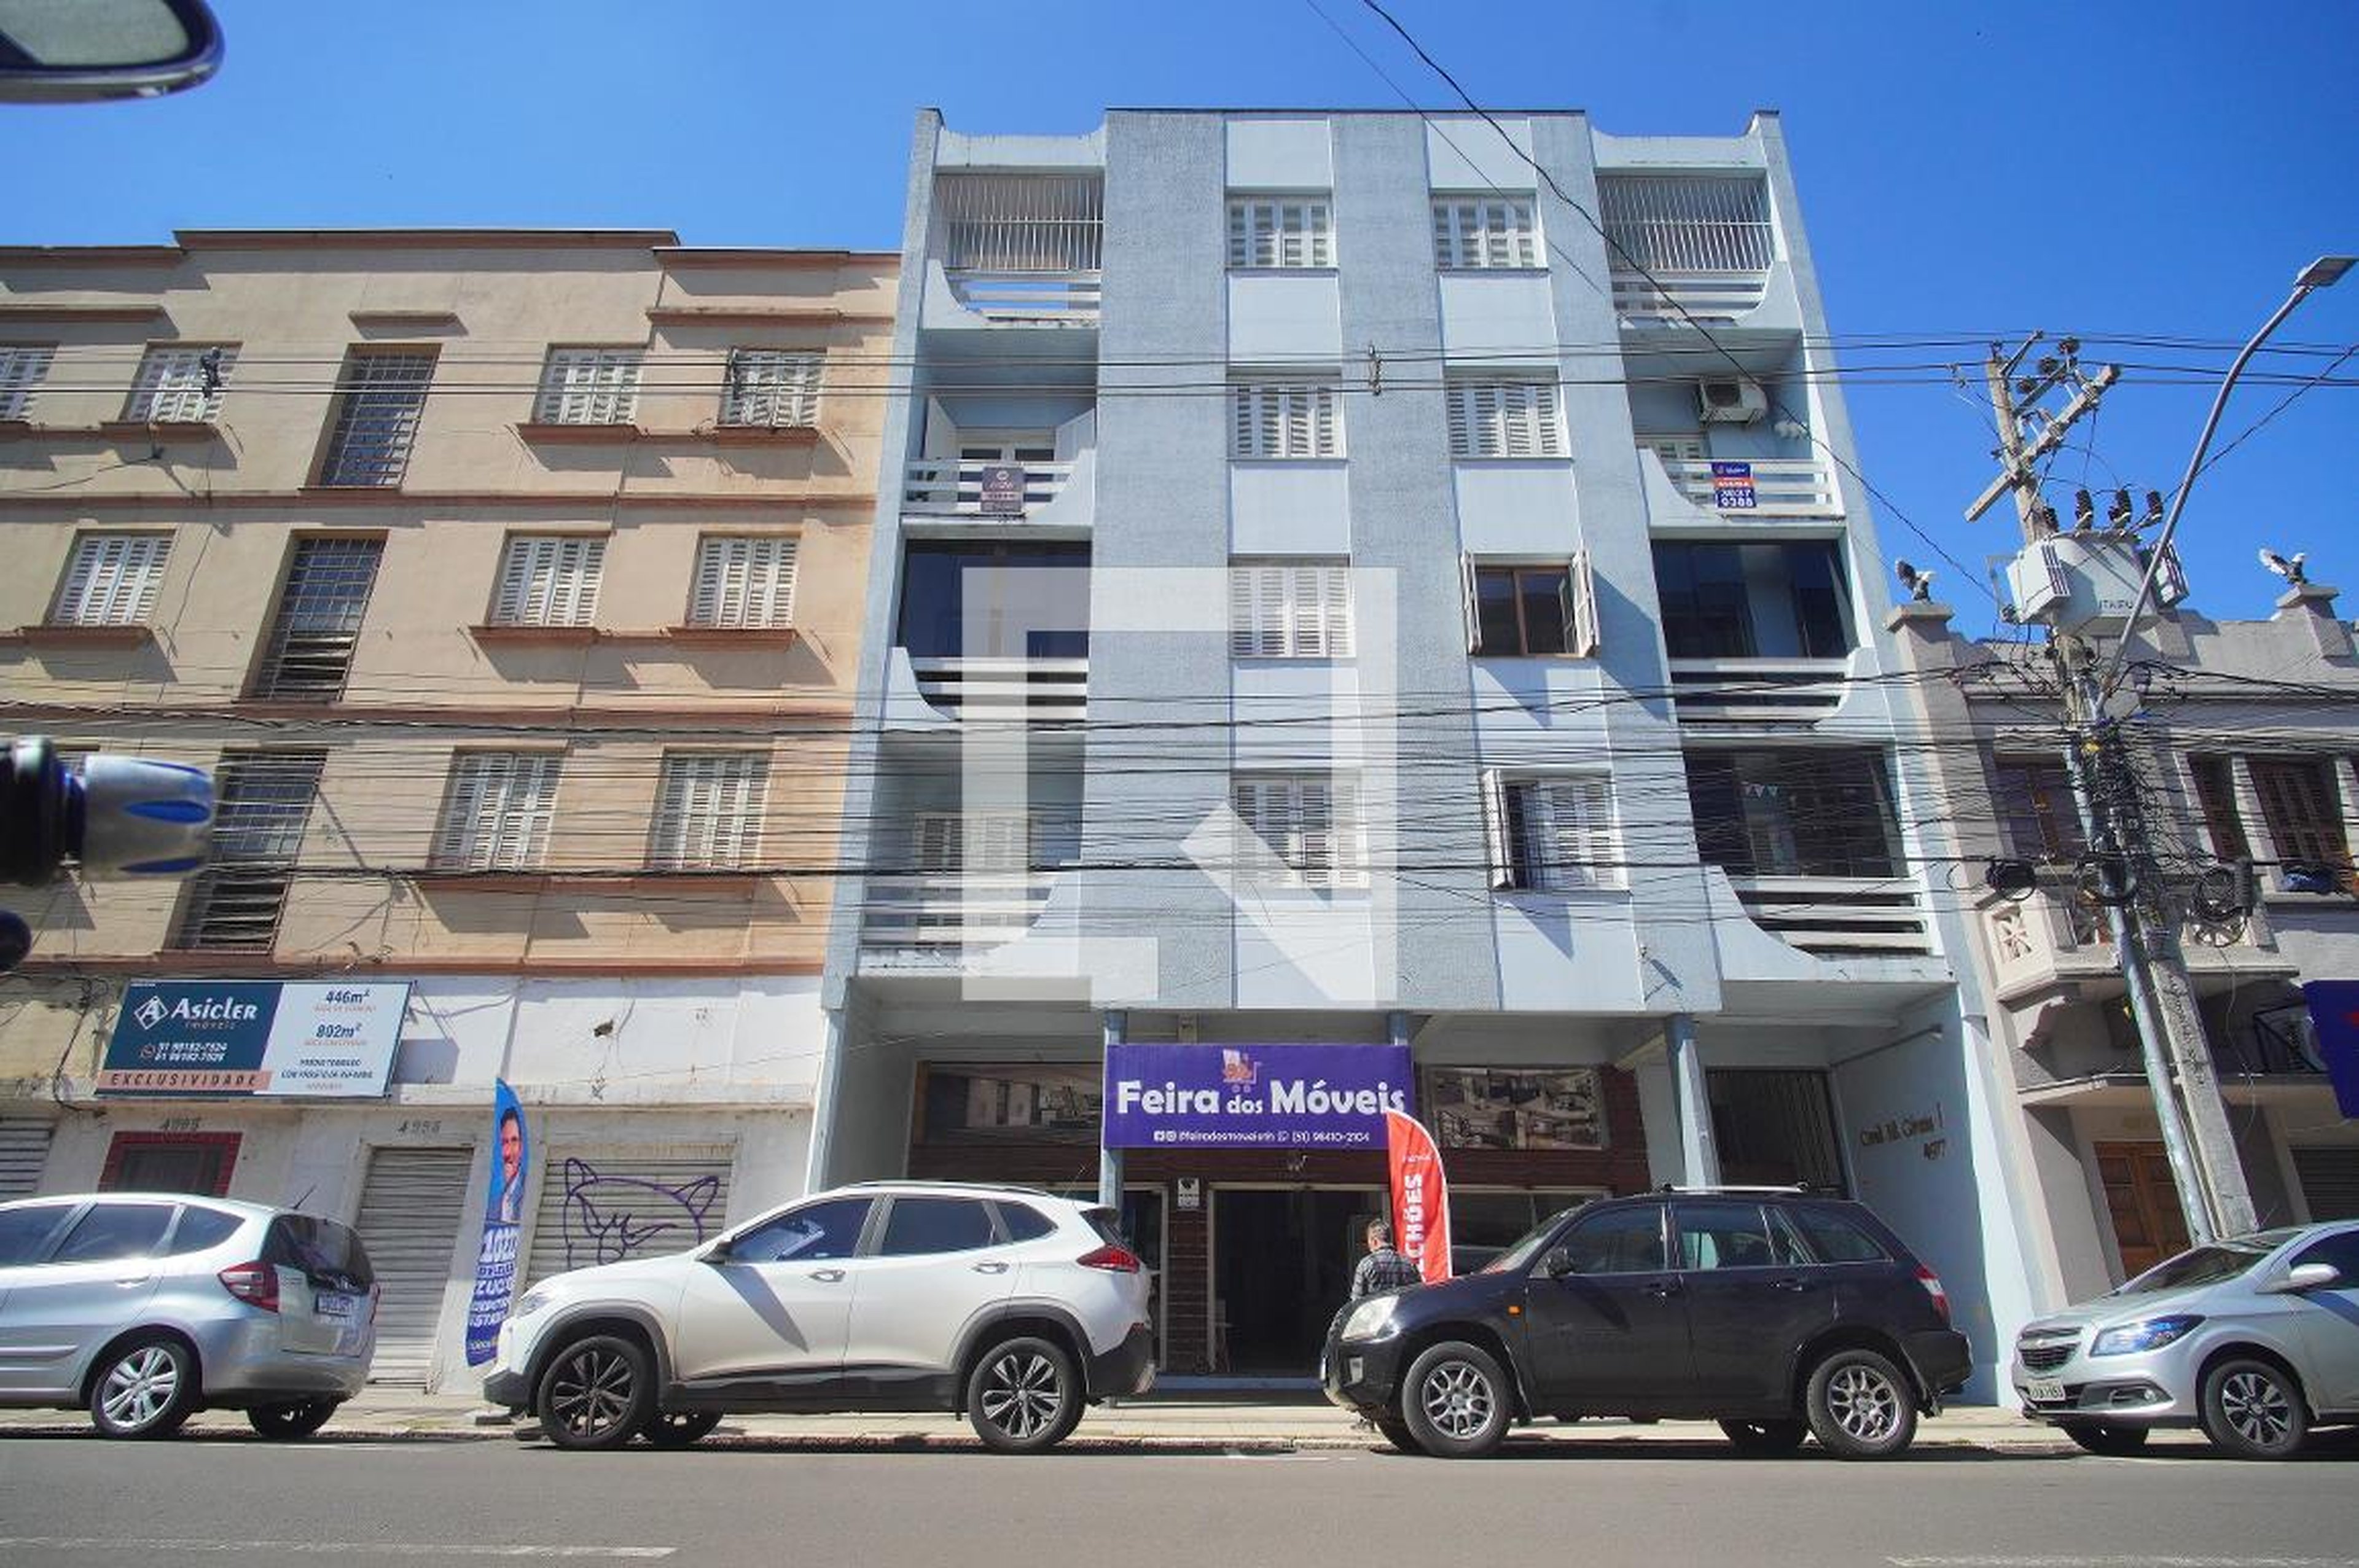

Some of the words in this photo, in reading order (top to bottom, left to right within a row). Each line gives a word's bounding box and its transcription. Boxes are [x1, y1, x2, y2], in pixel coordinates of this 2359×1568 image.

[110, 1074, 257, 1086] EXCLUSIVIDADE
[1117, 1079, 1220, 1115] Feira
[1227, 1094, 1264, 1115] dos
[1269, 1079, 1406, 1115] Móveis
[1403, 1173, 1425, 1266] CHÕES
